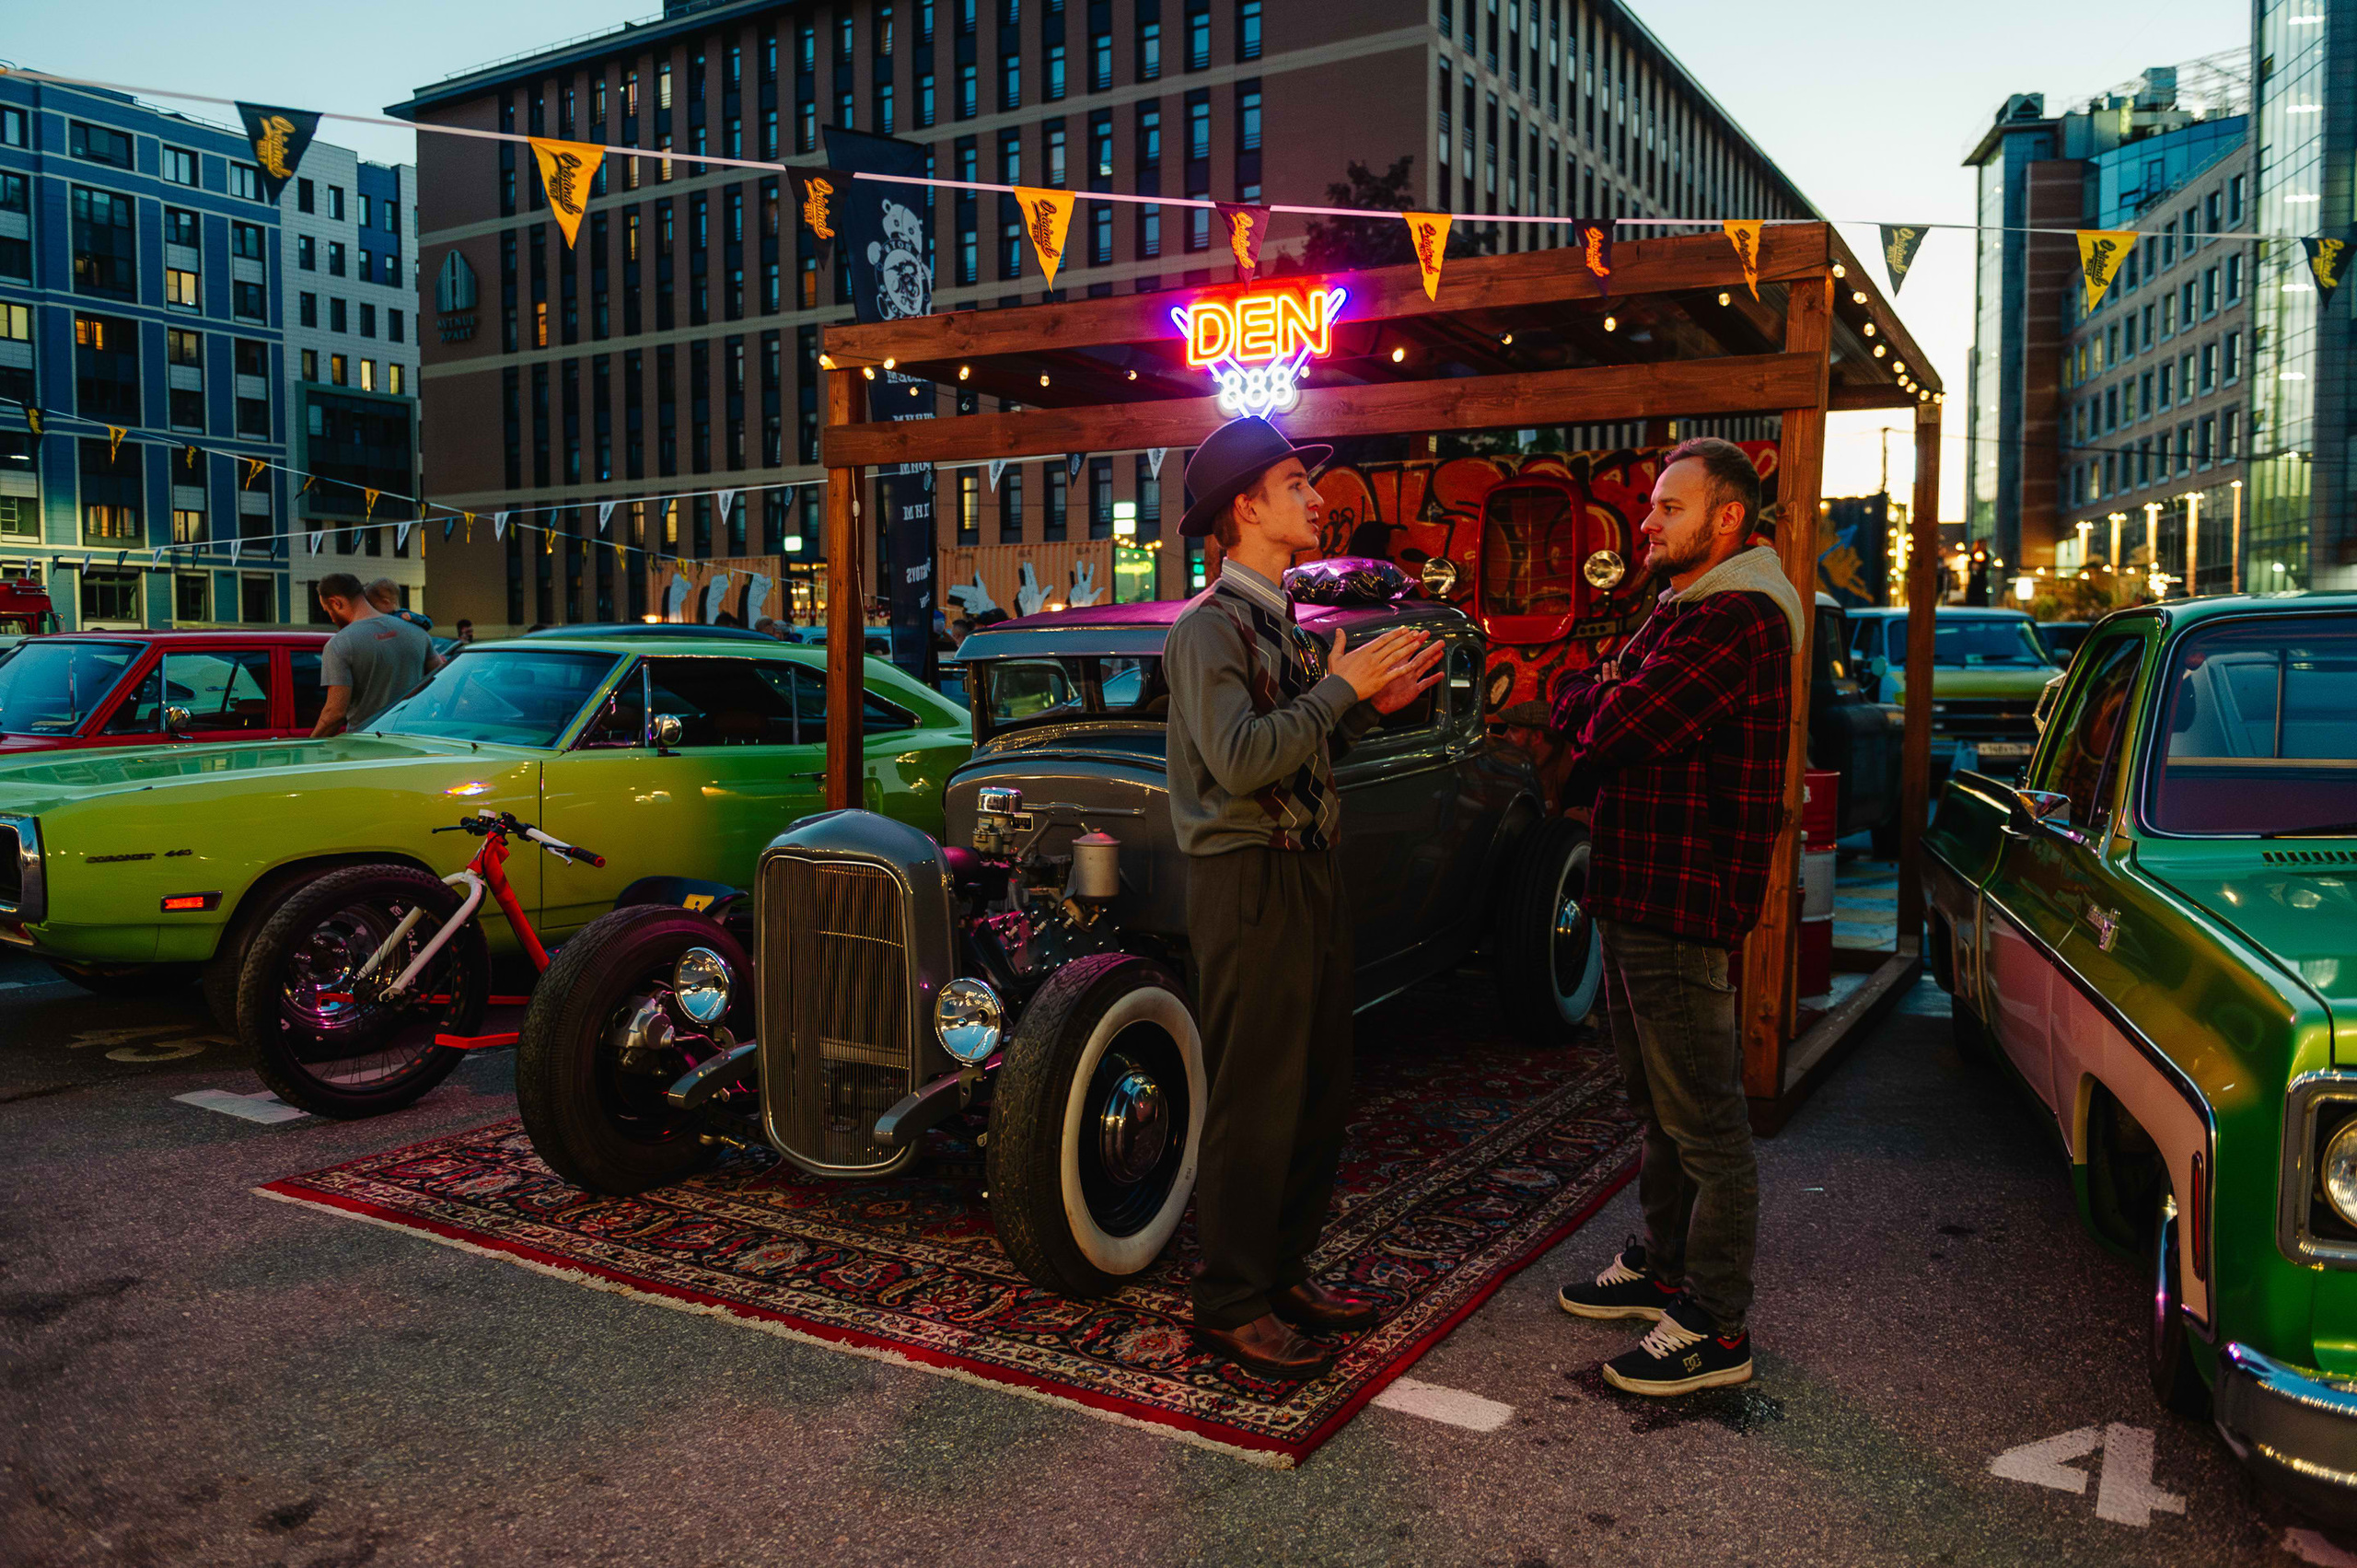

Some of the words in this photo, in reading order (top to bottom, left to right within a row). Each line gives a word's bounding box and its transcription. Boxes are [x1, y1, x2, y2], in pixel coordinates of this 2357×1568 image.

[261, 115, 296, 179] Original
[552, 151, 583, 215] Original
[804, 177, 835, 239] Original
[1031, 199, 1061, 259] Original
[1230, 212, 1255, 269] Original
[1418, 222, 1439, 274] Original
[1585, 226, 1610, 277] Original
[1892, 227, 1915, 274] Original
[2092, 239, 2117, 286] Original
[1188, 290, 1329, 366] DEN
[1221, 366, 1295, 411] 888
[1682, 1353, 1702, 1373] DC
[1989, 1422, 2187, 1527] 4
